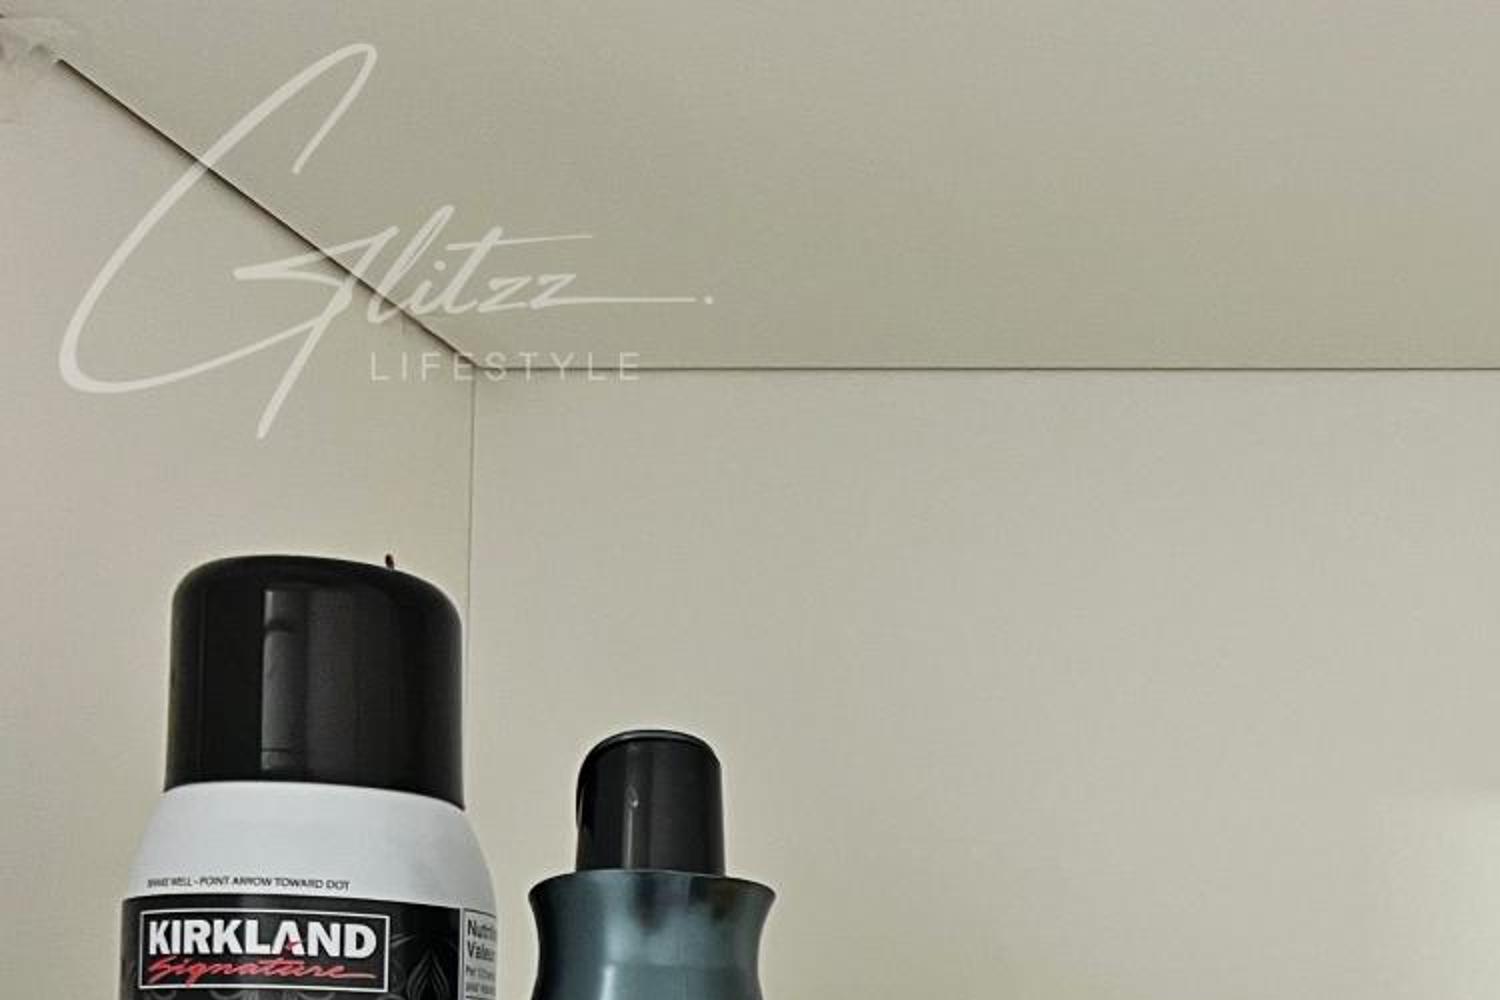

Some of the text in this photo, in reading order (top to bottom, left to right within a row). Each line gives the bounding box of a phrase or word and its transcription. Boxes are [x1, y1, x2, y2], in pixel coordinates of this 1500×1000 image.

[233, 877, 271, 887] ARROW
[275, 877, 322, 889] TOWARD
[326, 879, 350, 891] DOT
[148, 919, 377, 959] KIRKLAND
[147, 955, 376, 987] Signature
